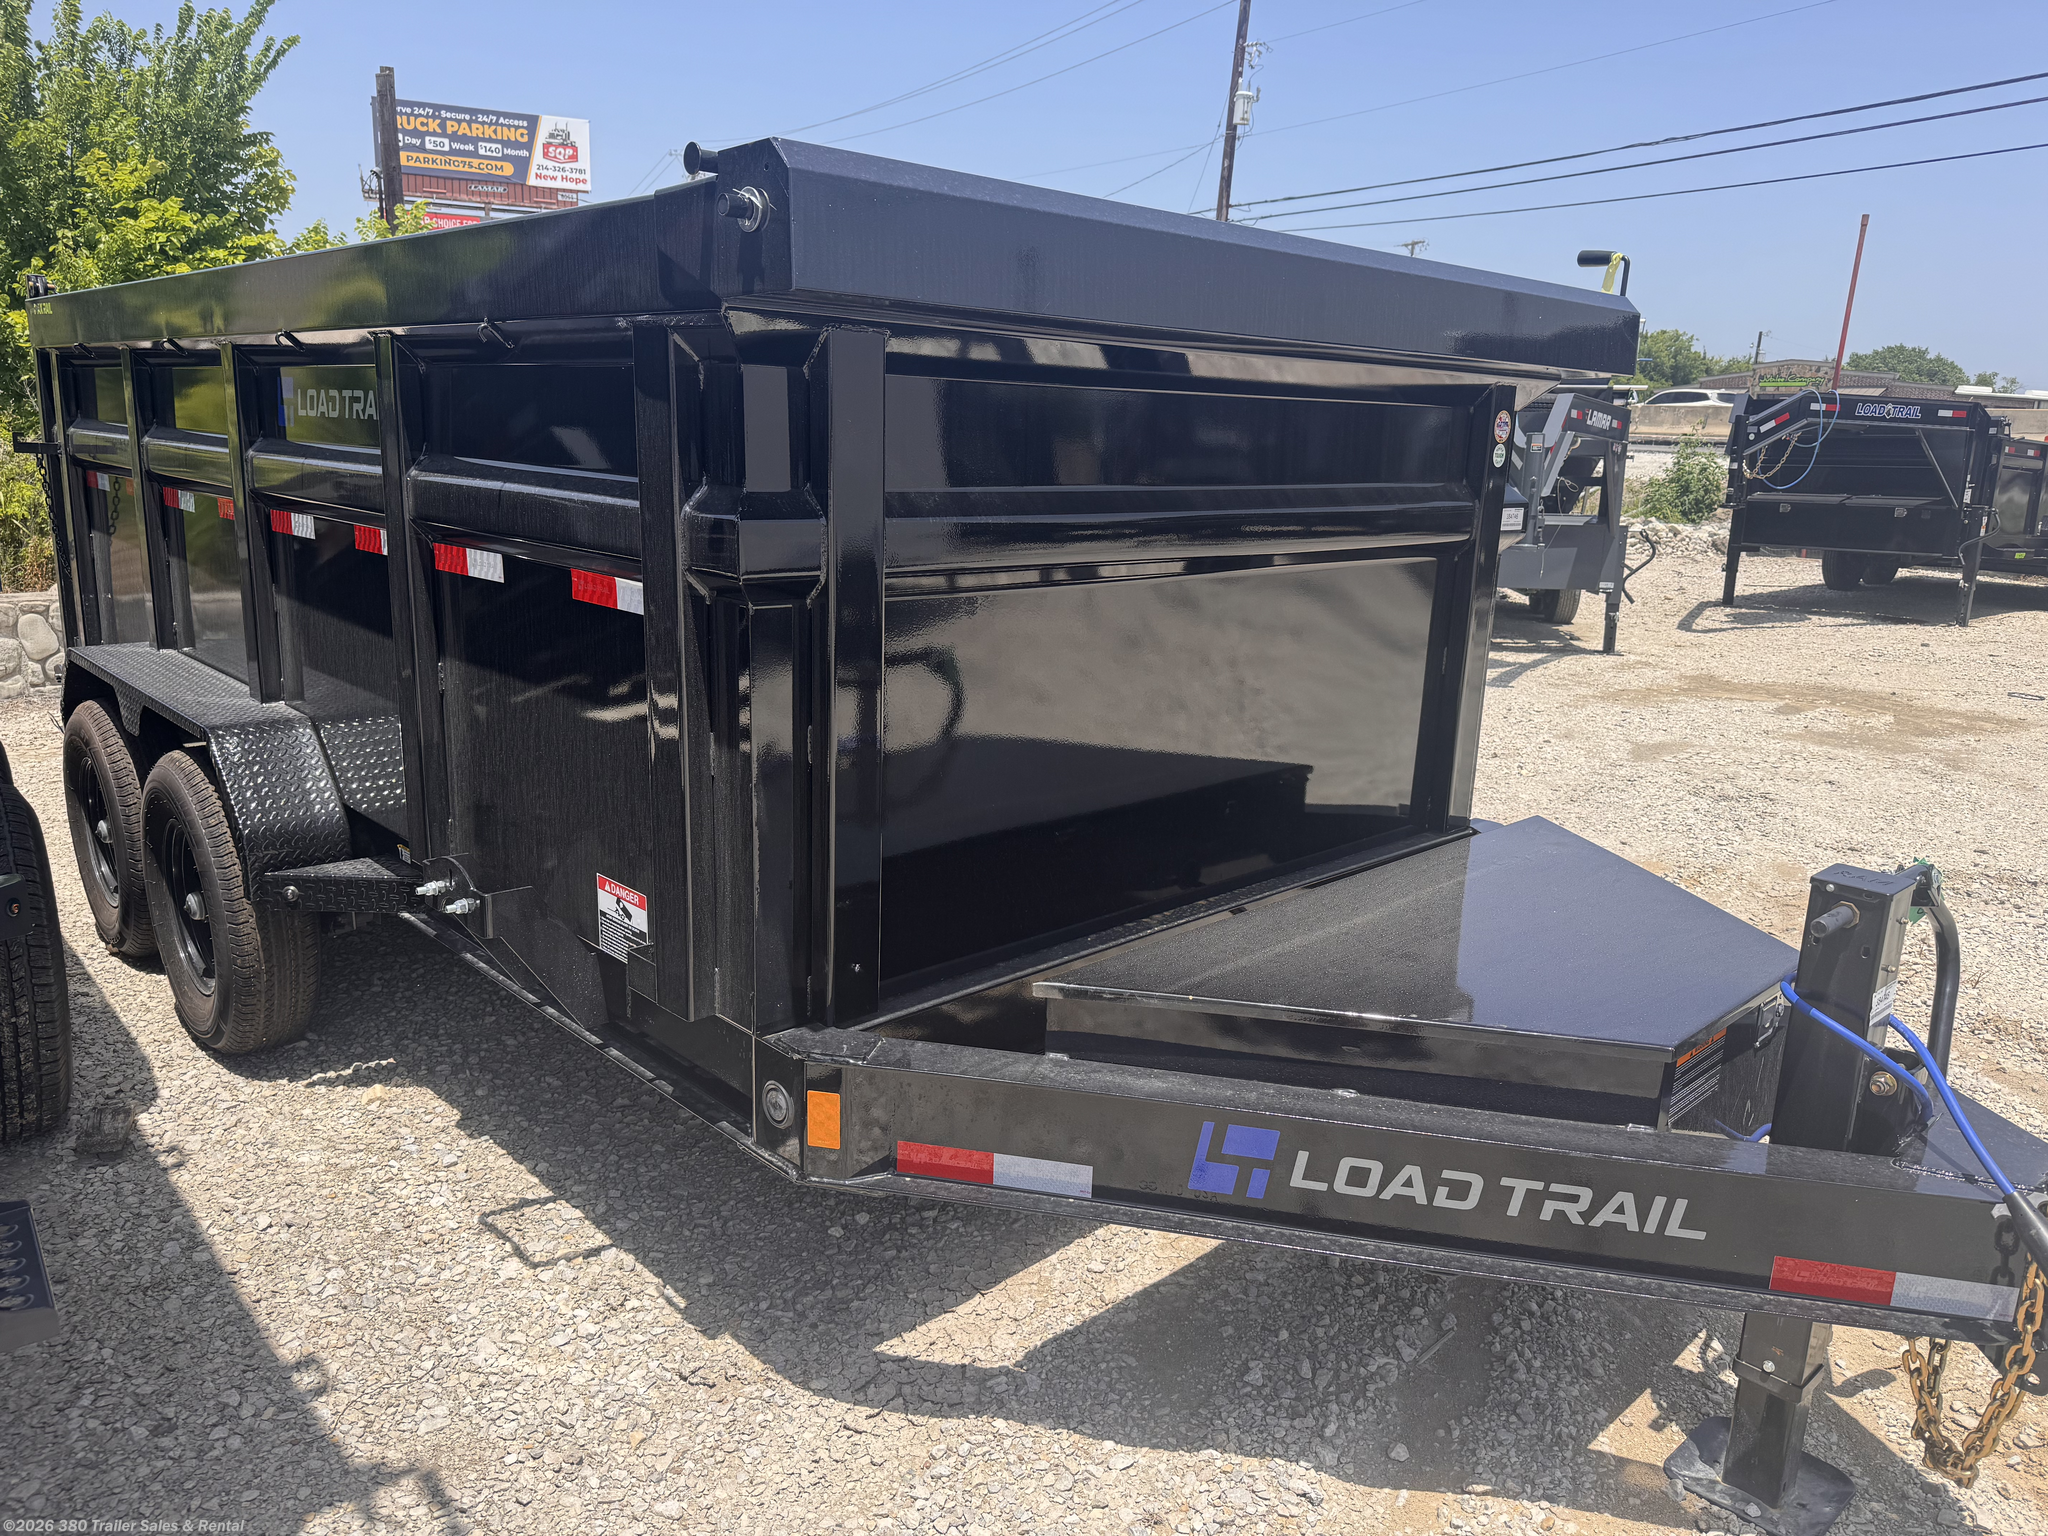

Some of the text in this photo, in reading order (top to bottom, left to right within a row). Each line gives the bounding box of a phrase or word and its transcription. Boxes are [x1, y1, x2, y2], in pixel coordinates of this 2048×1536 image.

[396, 106, 528, 127] rve 24/7 Secure 24/7 Access
[446, 120, 529, 143] PARKING
[404, 136, 530, 157] Day $50 Week $140 Month
[547, 146, 574, 161] SQP
[406, 155, 504, 173] PARKING75.COM
[535, 172, 588, 185] New Hope
[298, 388, 339, 418] LOAD
[1855, 402, 1921, 418] LOAD TRAIL
[1586, 409, 1612, 430] LAMAR
[610, 883, 639, 905] DANGER
[1289, 1150, 1708, 1241] LOAD TRAIL
